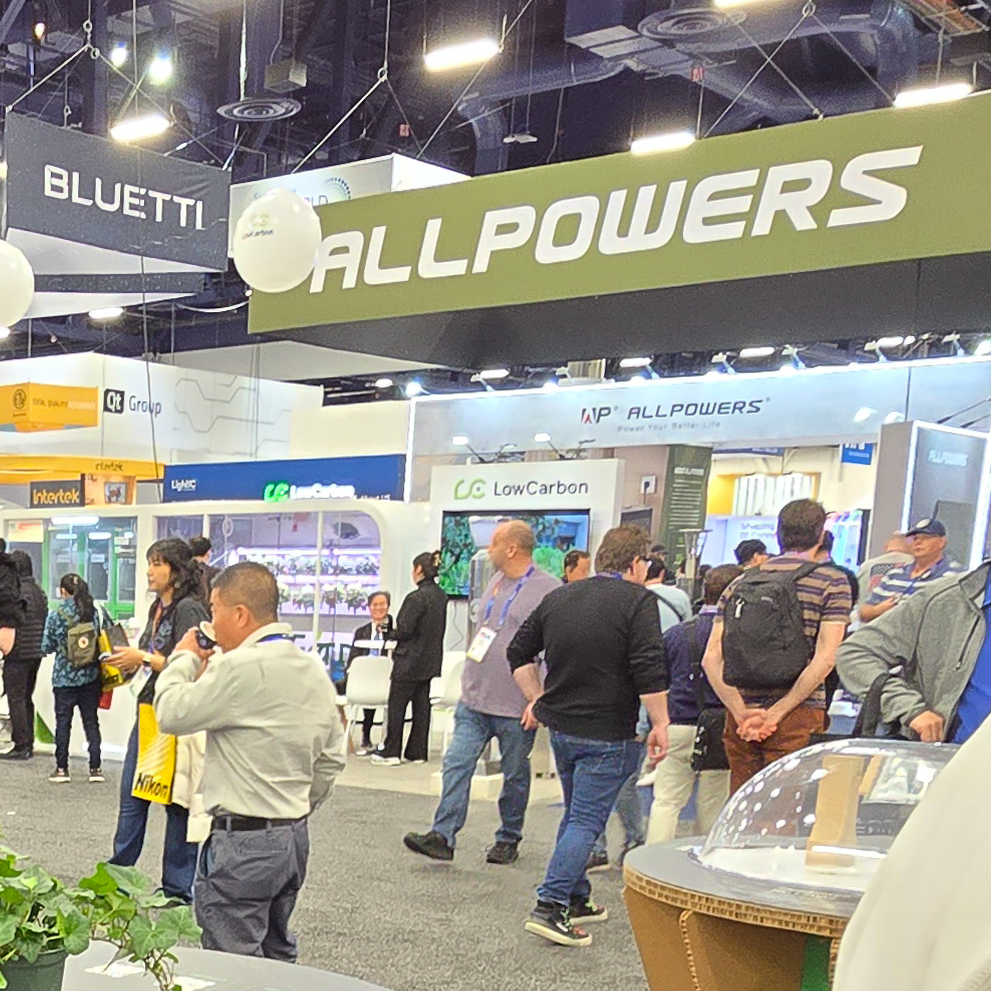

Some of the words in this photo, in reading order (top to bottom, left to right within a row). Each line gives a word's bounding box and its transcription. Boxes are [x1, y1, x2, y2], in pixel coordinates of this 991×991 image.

[44, 164, 206, 231] BLUETTI
[309, 146, 923, 293] ALLPOWERS
[108, 392, 122, 412] Qt
[128, 395, 162, 417] Group
[627, 399, 764, 420] ALLPOWERS
[33, 488, 79, 506] intertek
[494, 480, 589, 497] LowCarbon
[135, 772, 169, 799] Nikon
